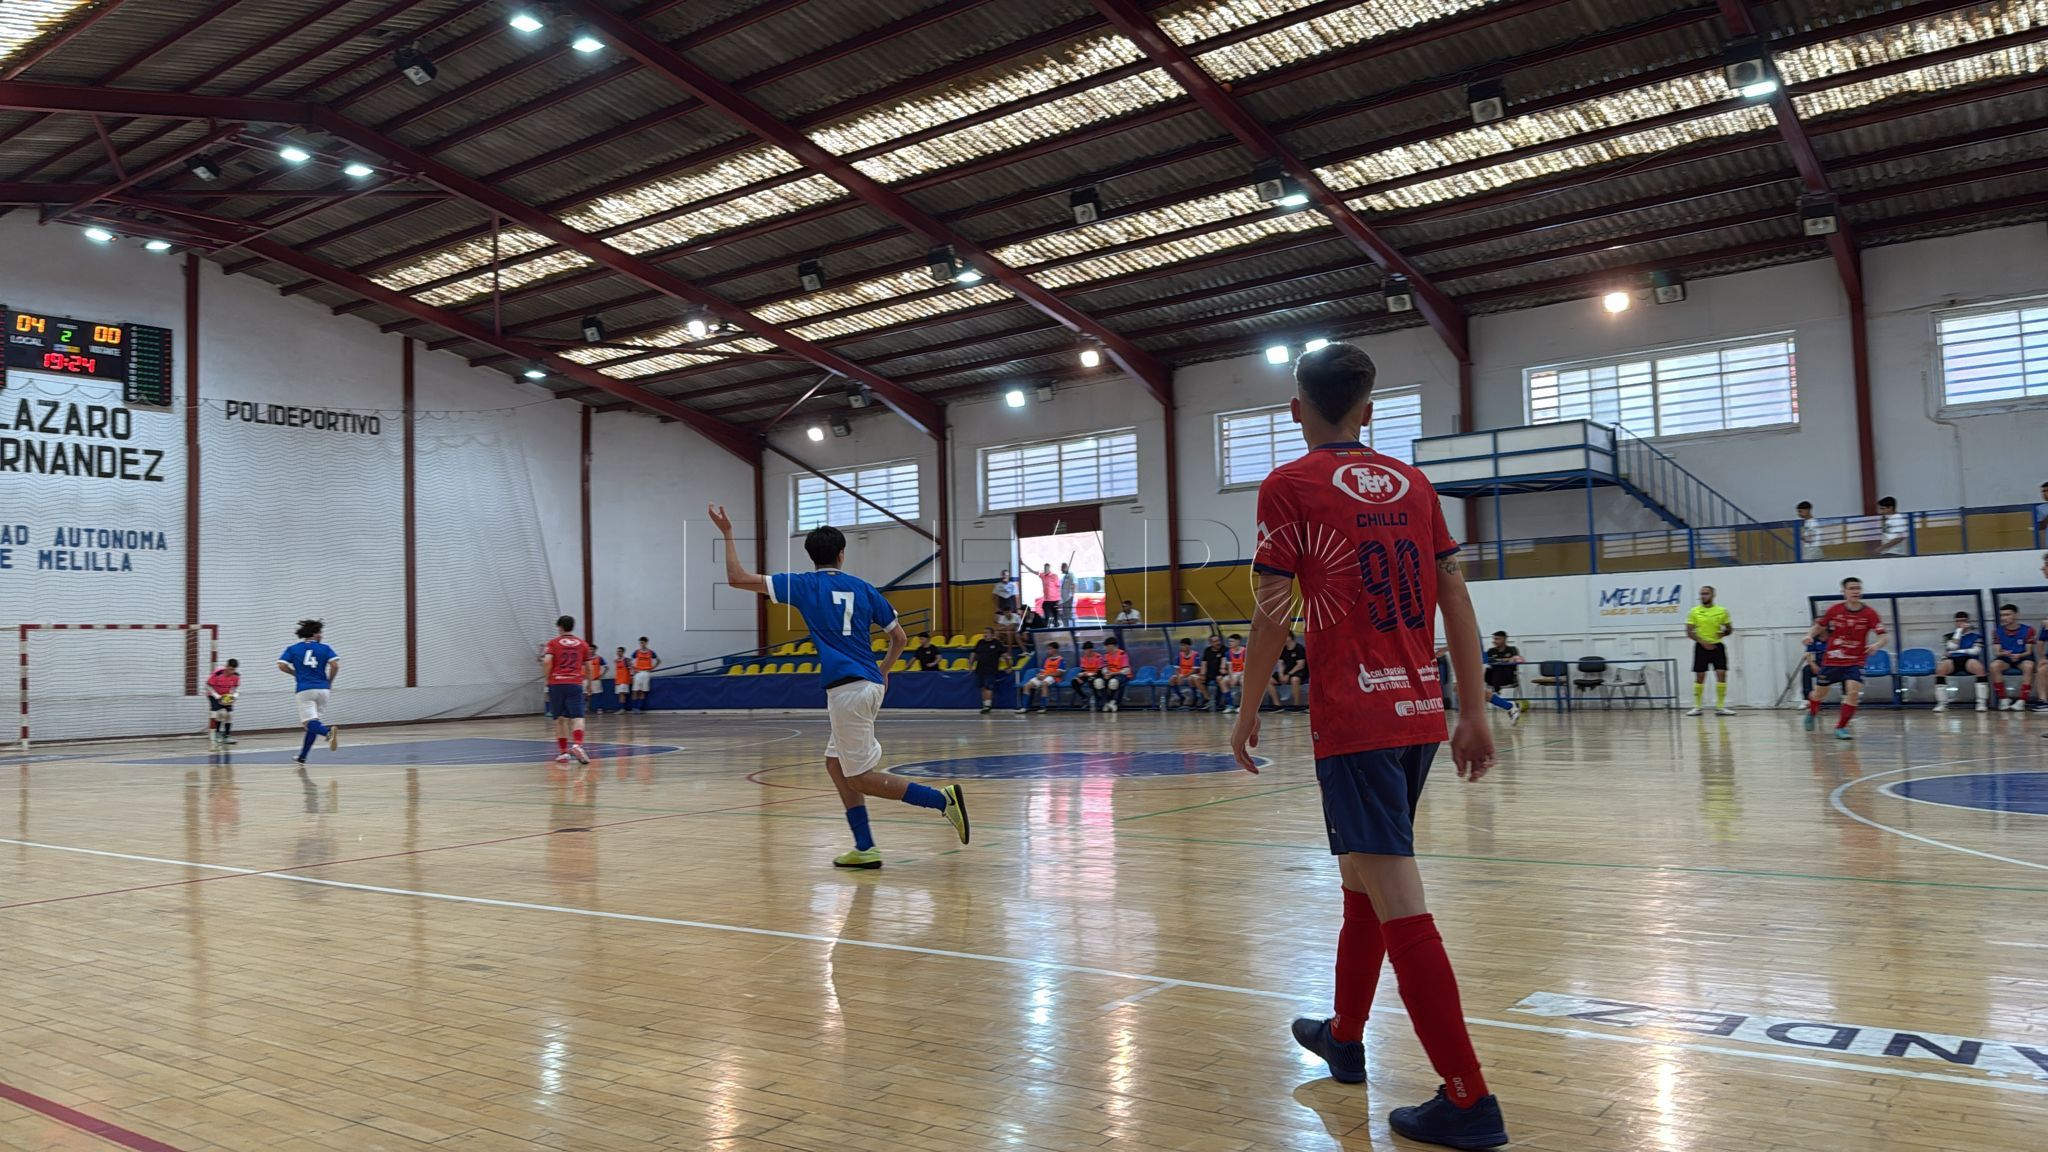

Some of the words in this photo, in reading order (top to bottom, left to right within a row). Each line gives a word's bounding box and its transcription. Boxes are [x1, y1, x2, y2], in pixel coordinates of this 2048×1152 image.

[16, 315, 46, 333] 04
[61, 330, 73, 342] 2
[93, 326, 122, 344] 00
[43, 353, 96, 373] 19:24
[226, 400, 380, 435] POLIDEPORTIVO
[1356, 512, 1408, 528] CHILLO
[53, 526, 168, 551] AUTONOMA
[38, 549, 133, 572] MELILLA
[1358, 538, 1426, 633] 90
[831, 590, 855, 636] 7
[302, 649, 319, 669] 4
